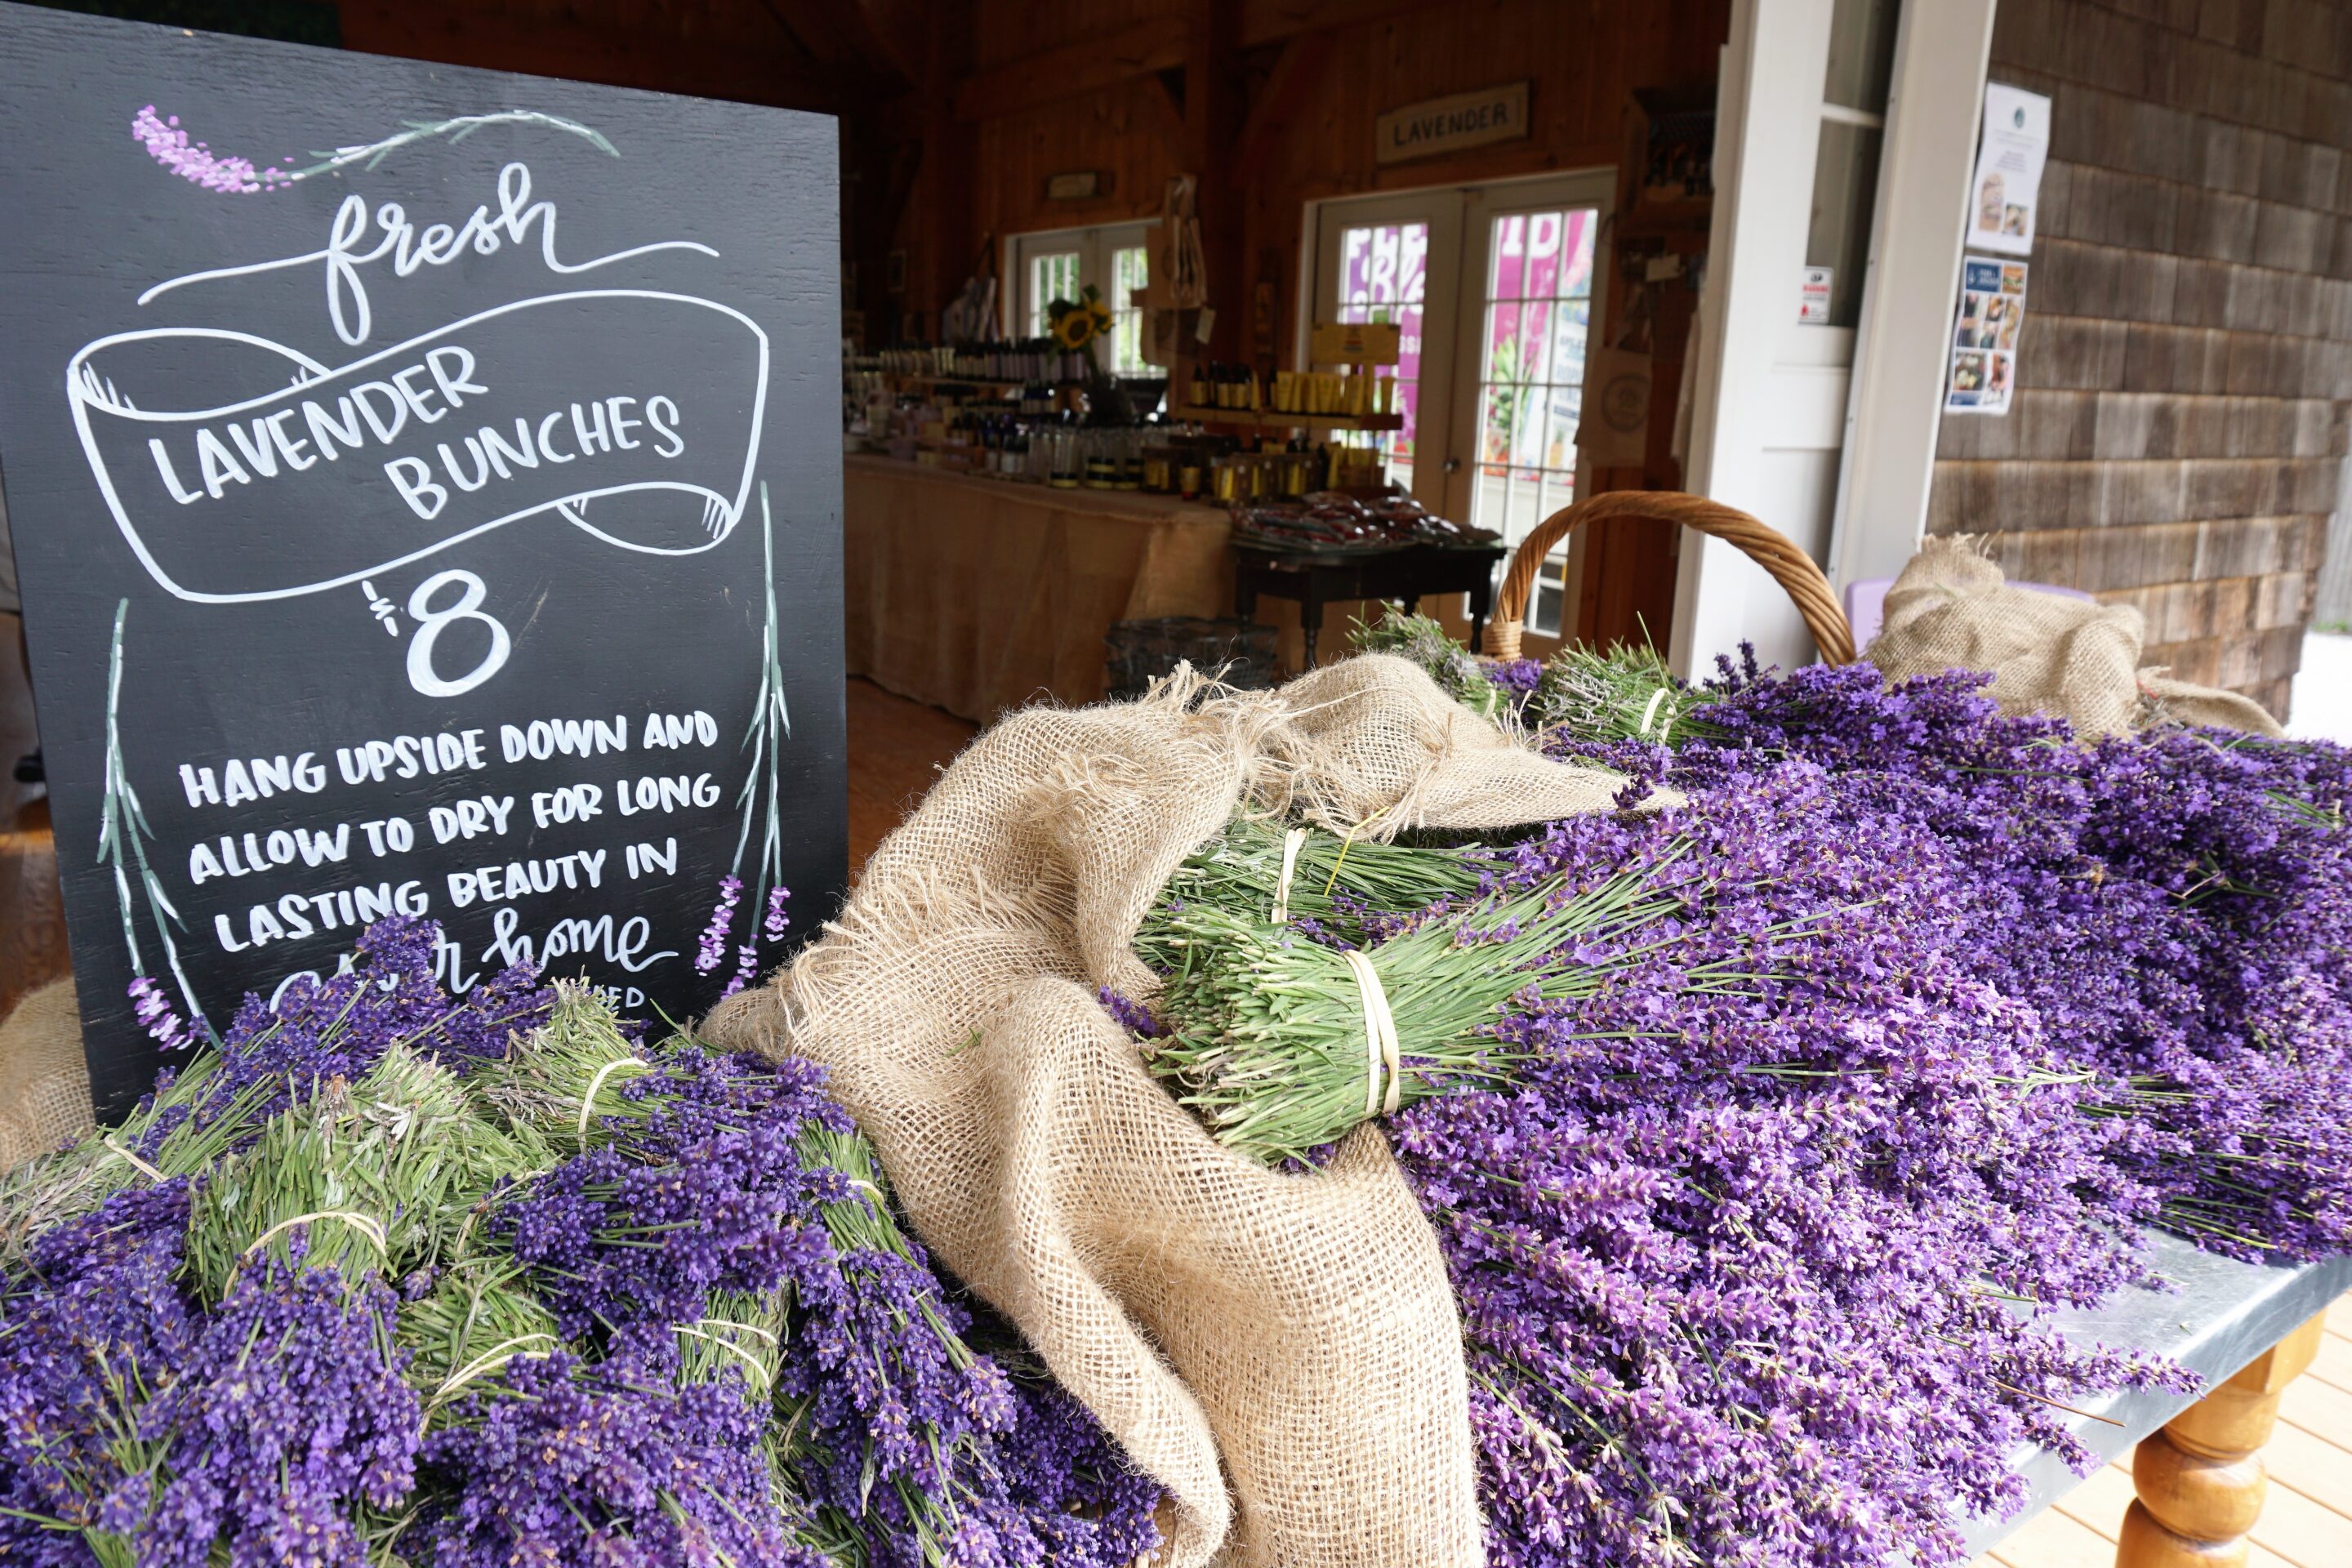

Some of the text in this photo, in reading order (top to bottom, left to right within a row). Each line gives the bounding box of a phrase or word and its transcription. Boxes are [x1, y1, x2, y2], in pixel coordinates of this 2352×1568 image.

[1393, 102, 1509, 147] LAVENDER
[149, 346, 489, 504] LAVENDER
[384, 395, 684, 520] BUNCHES
[179, 710, 718, 808] HANG UPSIDE DOWN AND
[190, 772, 720, 884] ALLOW TO DRY FOR LONG
[215, 838, 676, 951] LASTING BEAUTY IN
[482, 907, 679, 980] home
